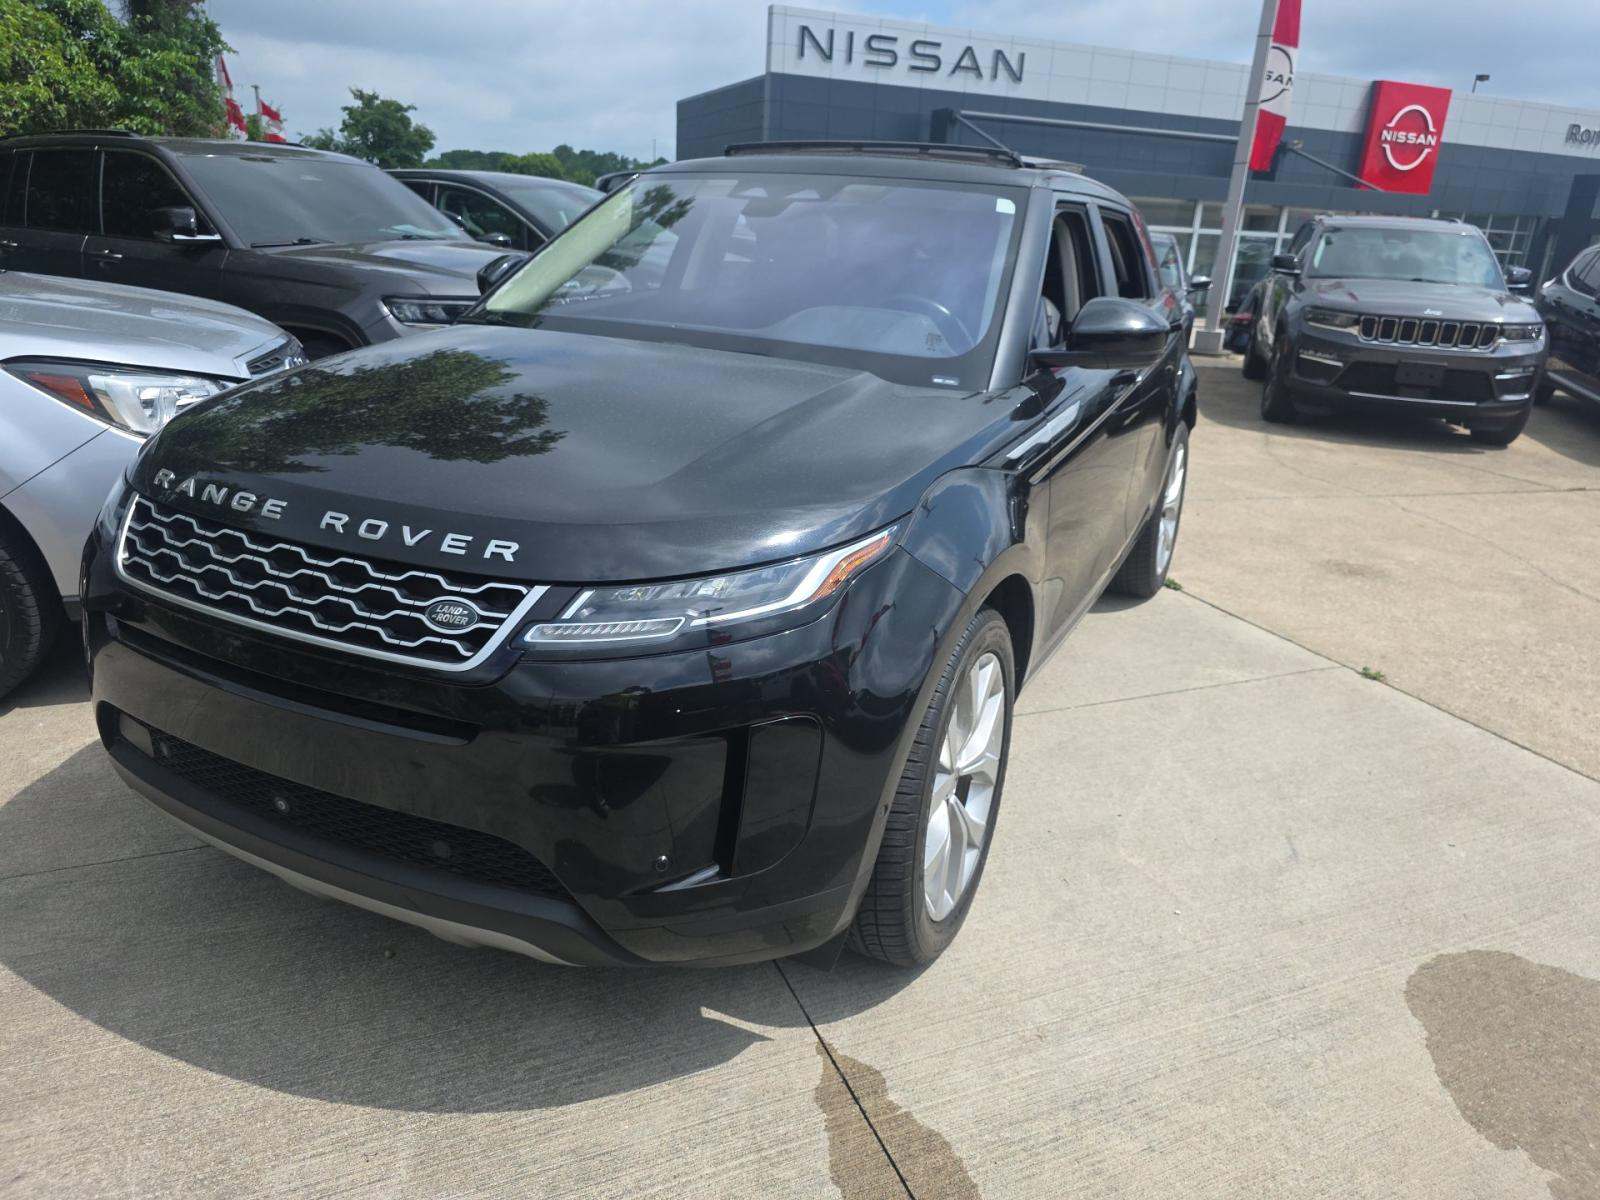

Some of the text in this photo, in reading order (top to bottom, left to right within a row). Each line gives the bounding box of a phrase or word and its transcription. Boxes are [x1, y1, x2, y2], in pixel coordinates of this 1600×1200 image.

[798, 25, 1025, 84] NISSAN
[1381, 129, 1437, 146] NISSAN
[153, 468, 521, 562] RANGE ROVER
